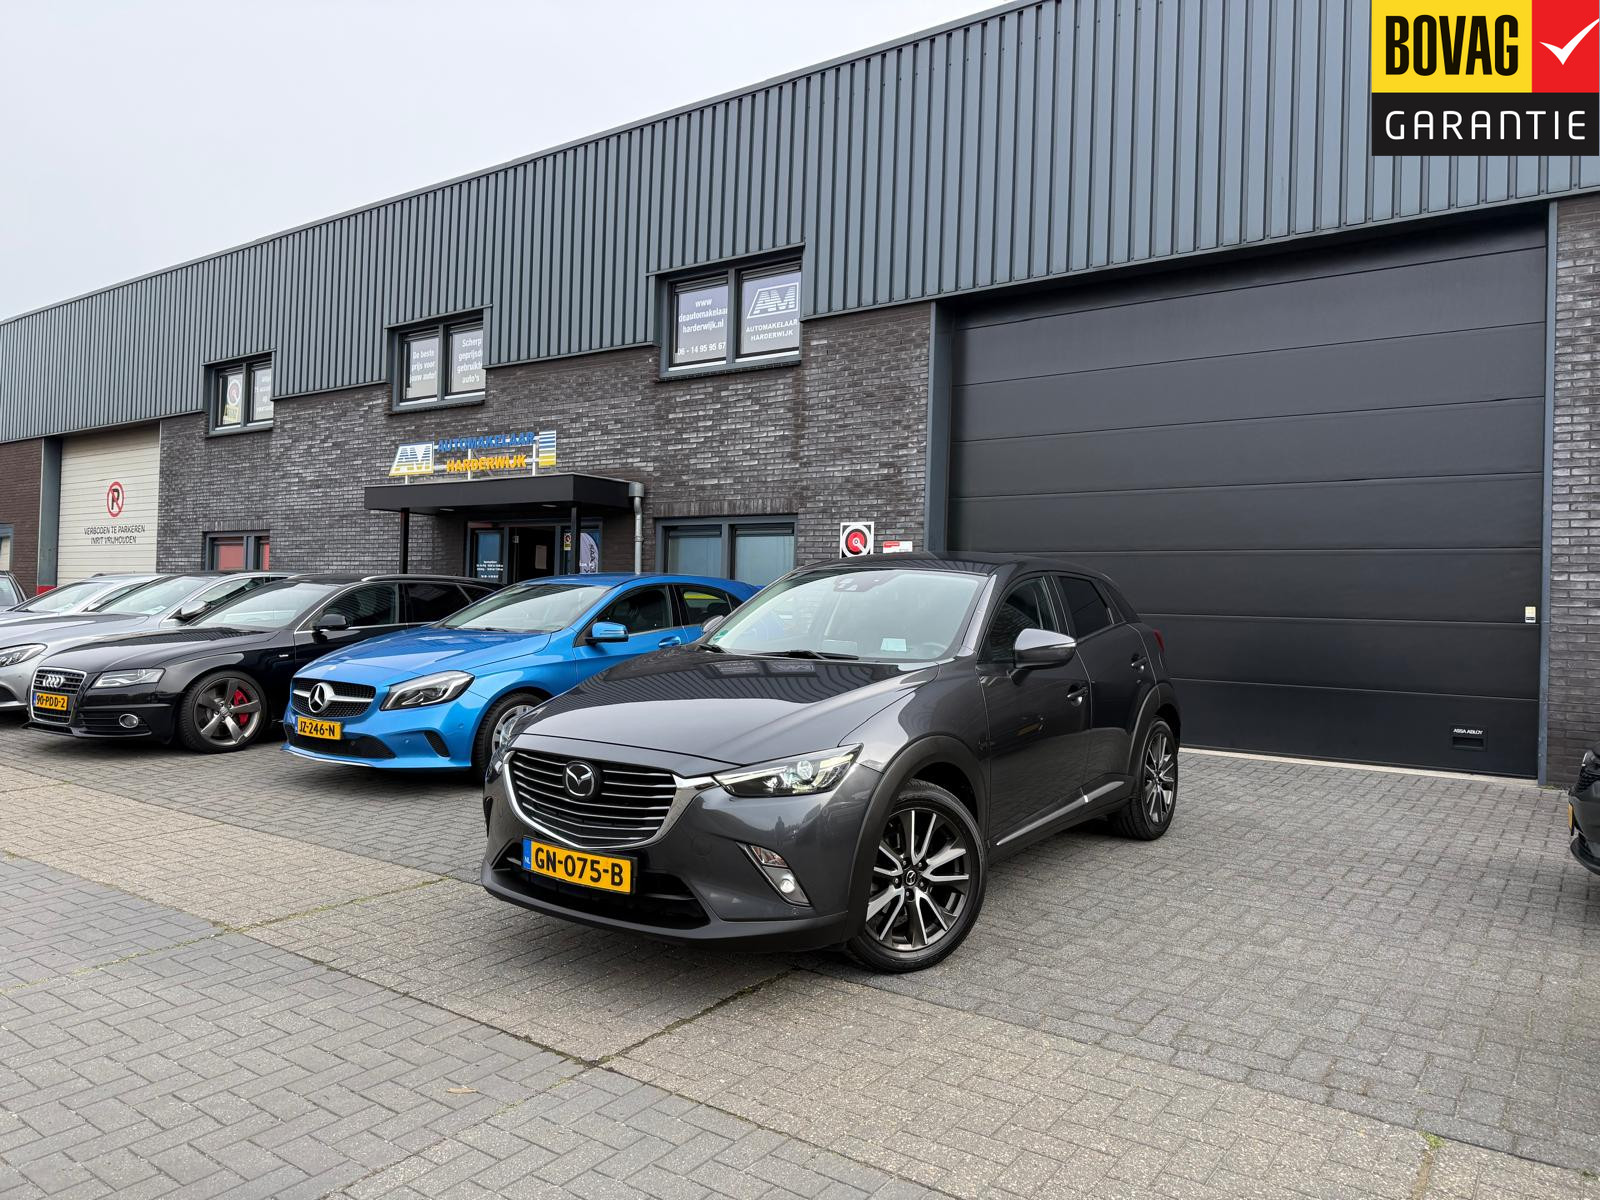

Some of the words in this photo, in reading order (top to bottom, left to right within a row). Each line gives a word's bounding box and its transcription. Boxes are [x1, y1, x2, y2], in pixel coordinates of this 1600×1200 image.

[695, 298, 713, 308] www
[682, 318, 724, 334] harderwijk.nl
[745, 318, 798, 333] AUTOMAKELAAR
[462, 337, 482, 348] Scherp
[750, 329, 794, 342] HARDERWIJK
[458, 349, 482, 362] geprijsd
[437, 431, 535, 453] AUTOMAKELAAR
[446, 454, 527, 473] HARDERWIJK
[84, 525, 110, 535] VERBODEN
[111, 525, 117, 534] TE
[118, 524, 146, 534] PARKEREN
[91, 537, 103, 545] INRIT
[36, 694, 66, 709] 90-PDD-2
[299, 720, 335, 737] JZ-246-N
[534, 846, 624, 887] GN-075-B
